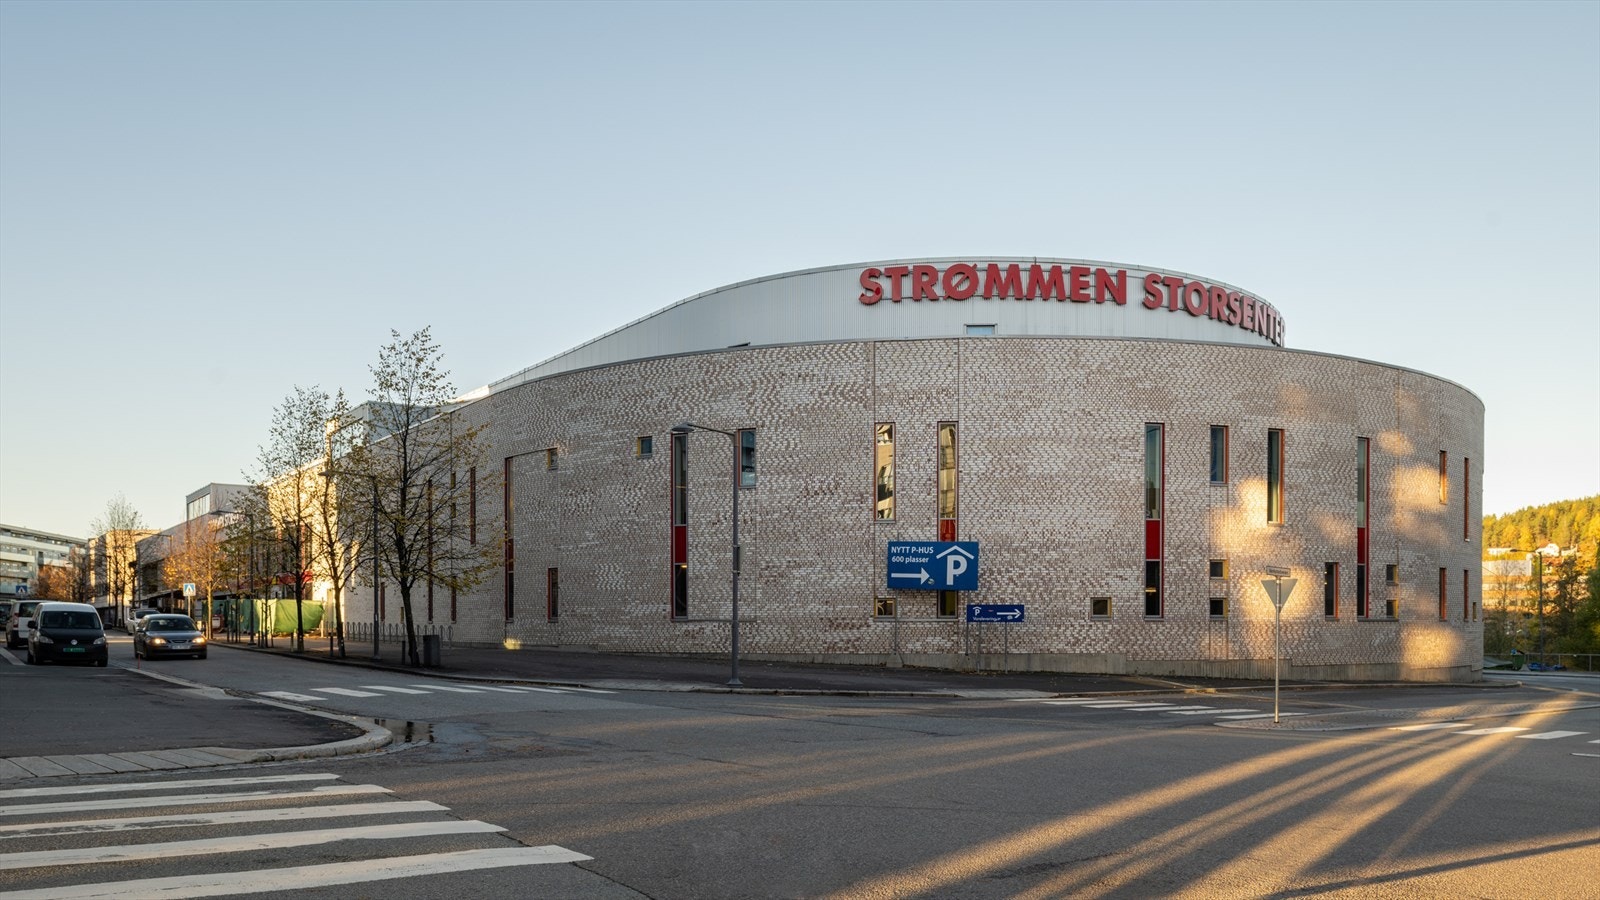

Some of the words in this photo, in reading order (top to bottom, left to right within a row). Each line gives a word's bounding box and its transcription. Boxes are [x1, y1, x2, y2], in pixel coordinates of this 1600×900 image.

[859, 263, 1127, 305] STRØMMEN
[911, 546, 934, 554] P-HUS
[905, 556, 929, 564] plasser
[946, 555, 967, 586] P
